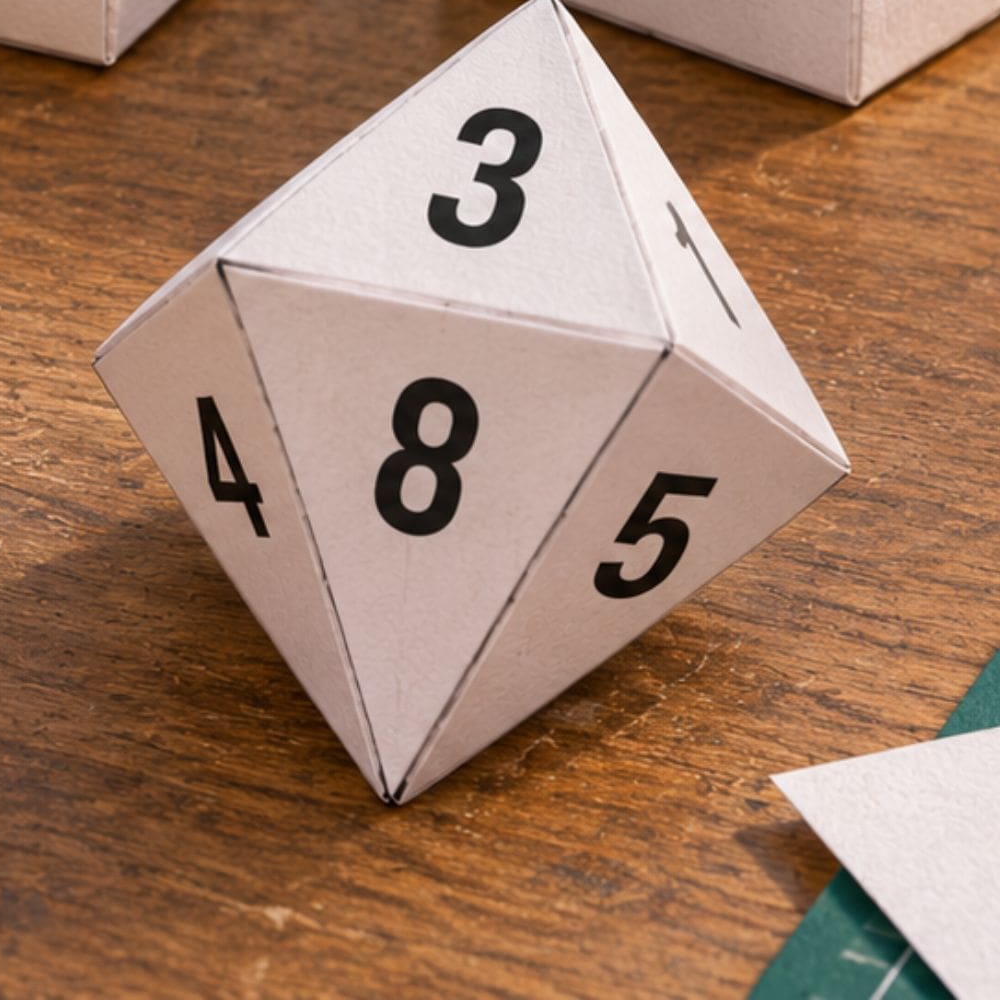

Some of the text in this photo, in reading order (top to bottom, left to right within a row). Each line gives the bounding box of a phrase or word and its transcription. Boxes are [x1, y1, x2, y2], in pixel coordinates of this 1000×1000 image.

[426, 107, 544, 248] 3
[195, 394, 271, 539] 4
[374, 376, 480, 537] 8
[593, 471, 718, 600] 5
